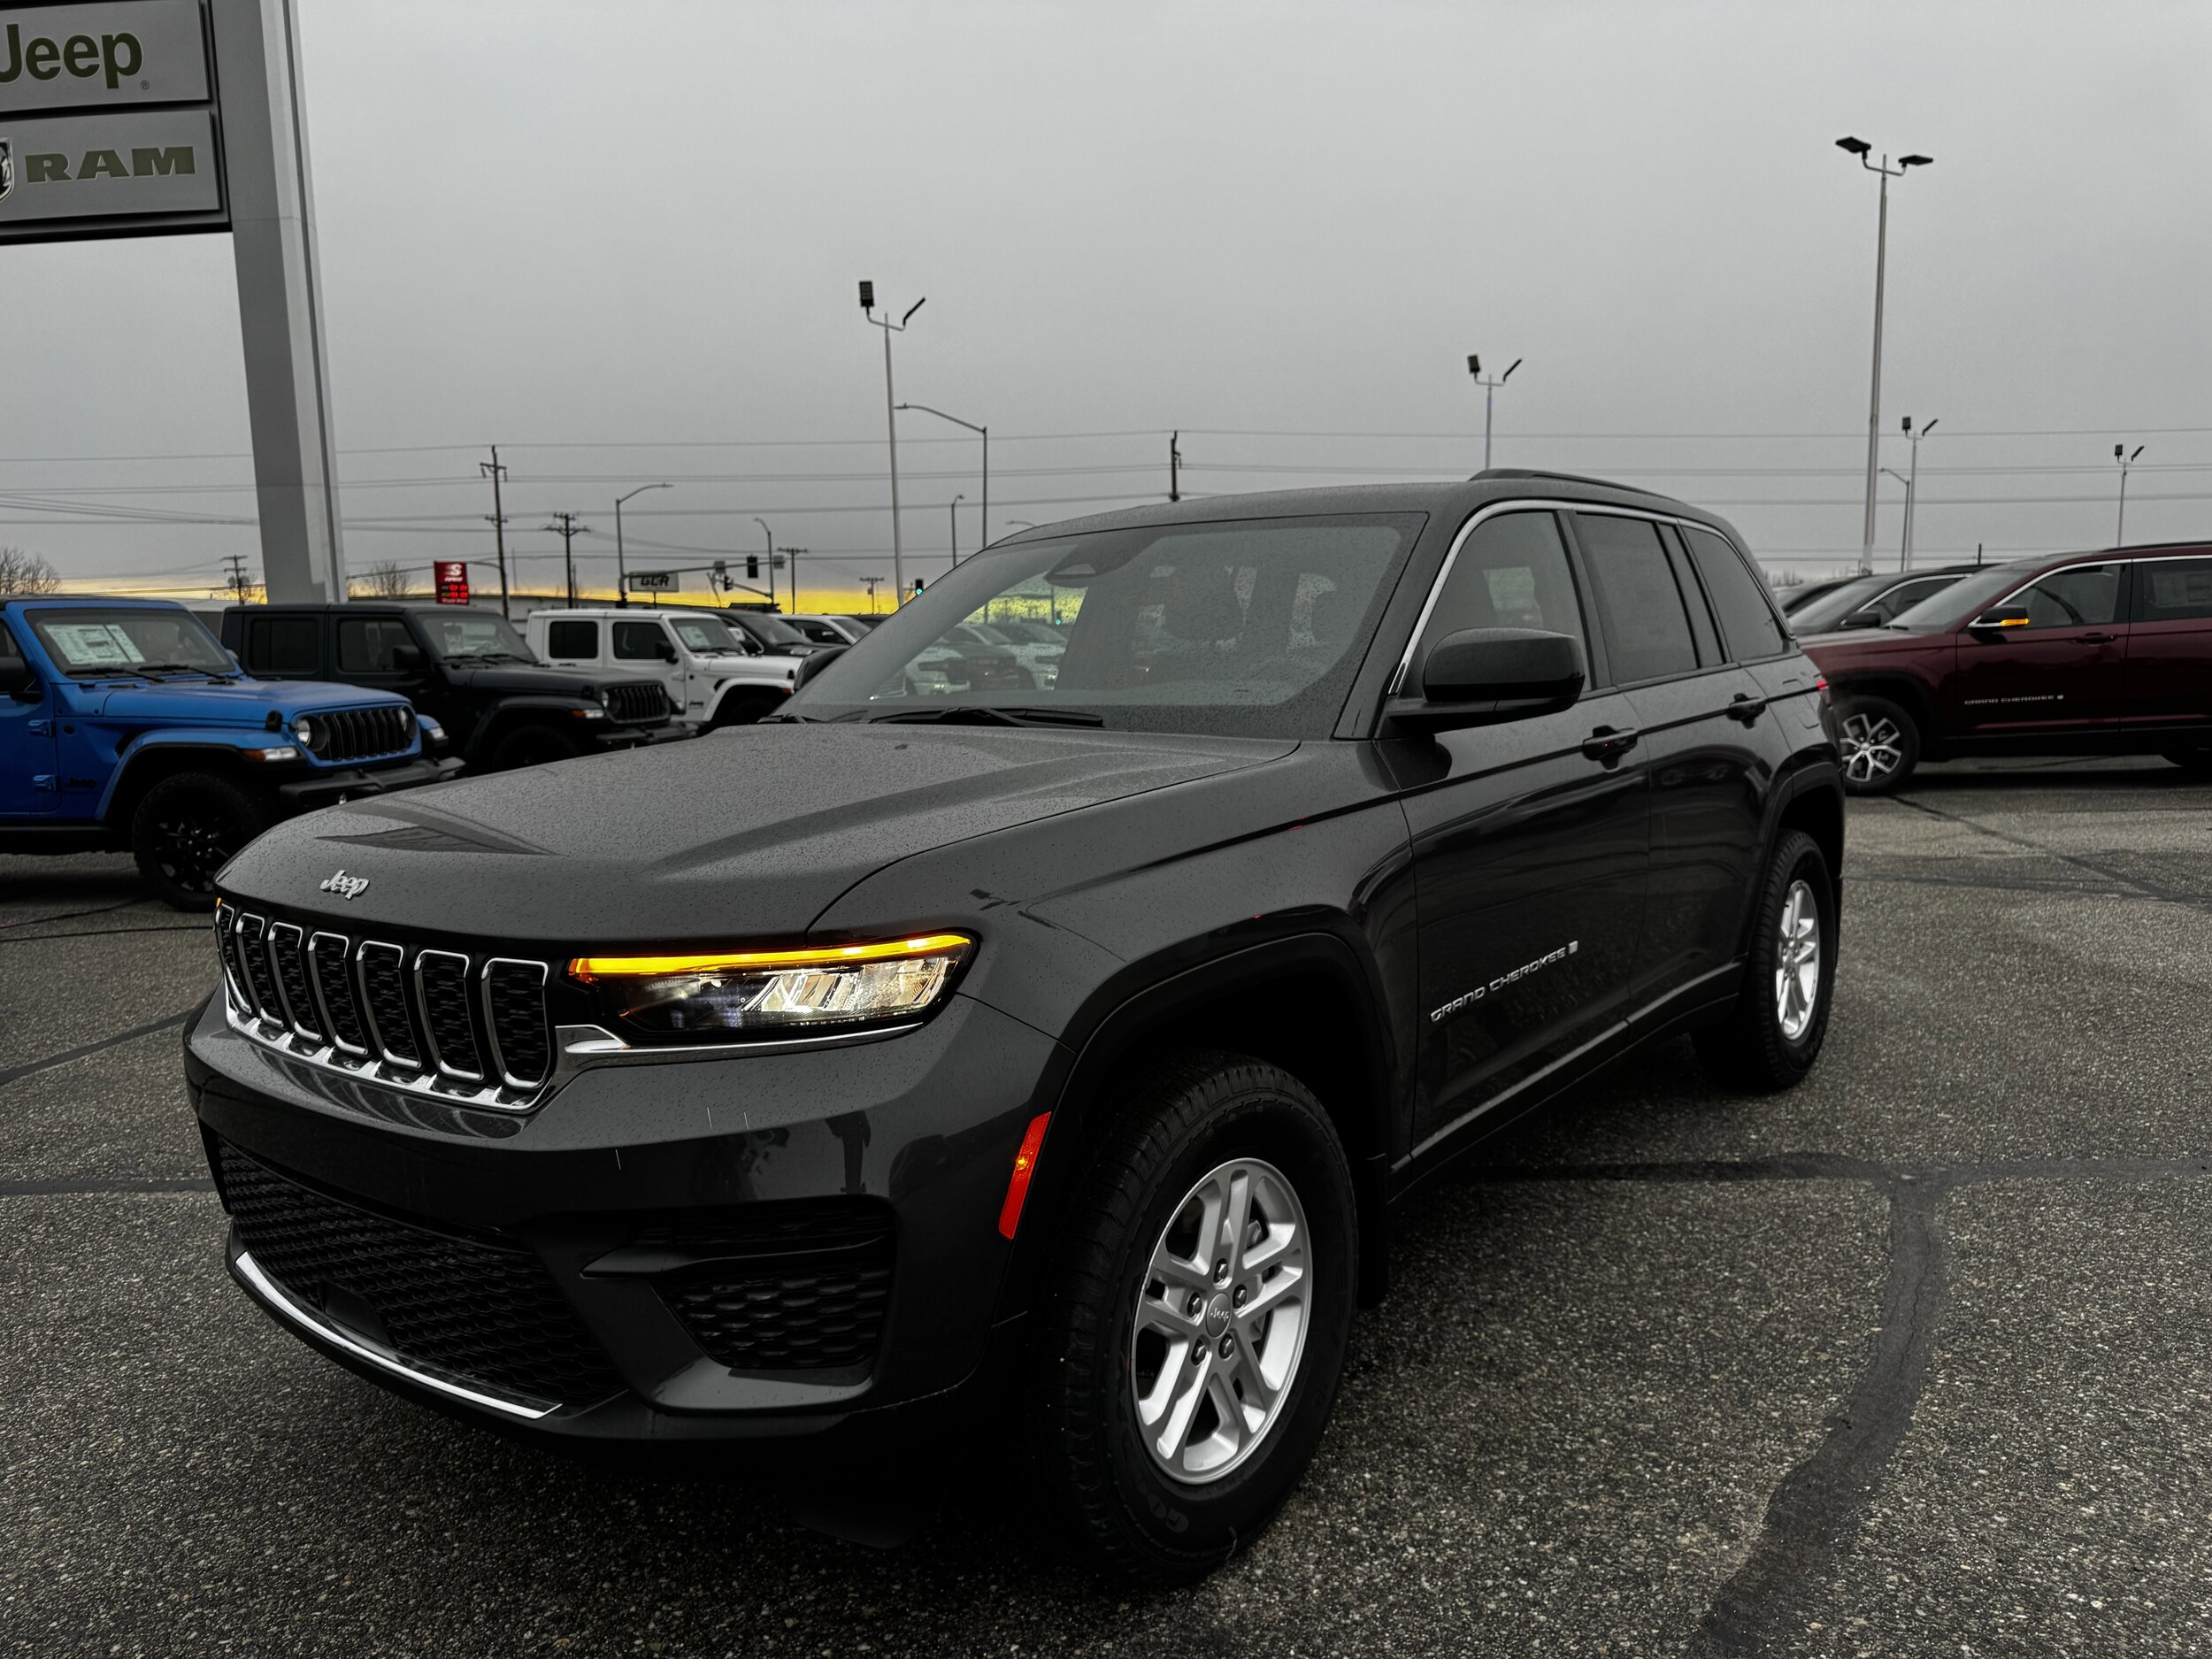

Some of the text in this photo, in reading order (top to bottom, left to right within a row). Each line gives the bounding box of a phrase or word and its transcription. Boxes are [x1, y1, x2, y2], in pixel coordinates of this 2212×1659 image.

[0, 23, 142, 89] Jeep
[25, 146, 196, 183] RAM
[319, 869, 370, 900] Jeep
[1430, 946, 1566, 1023] GRAND CHEROKEE
[1210, 1307, 1230, 1322] Jeep
